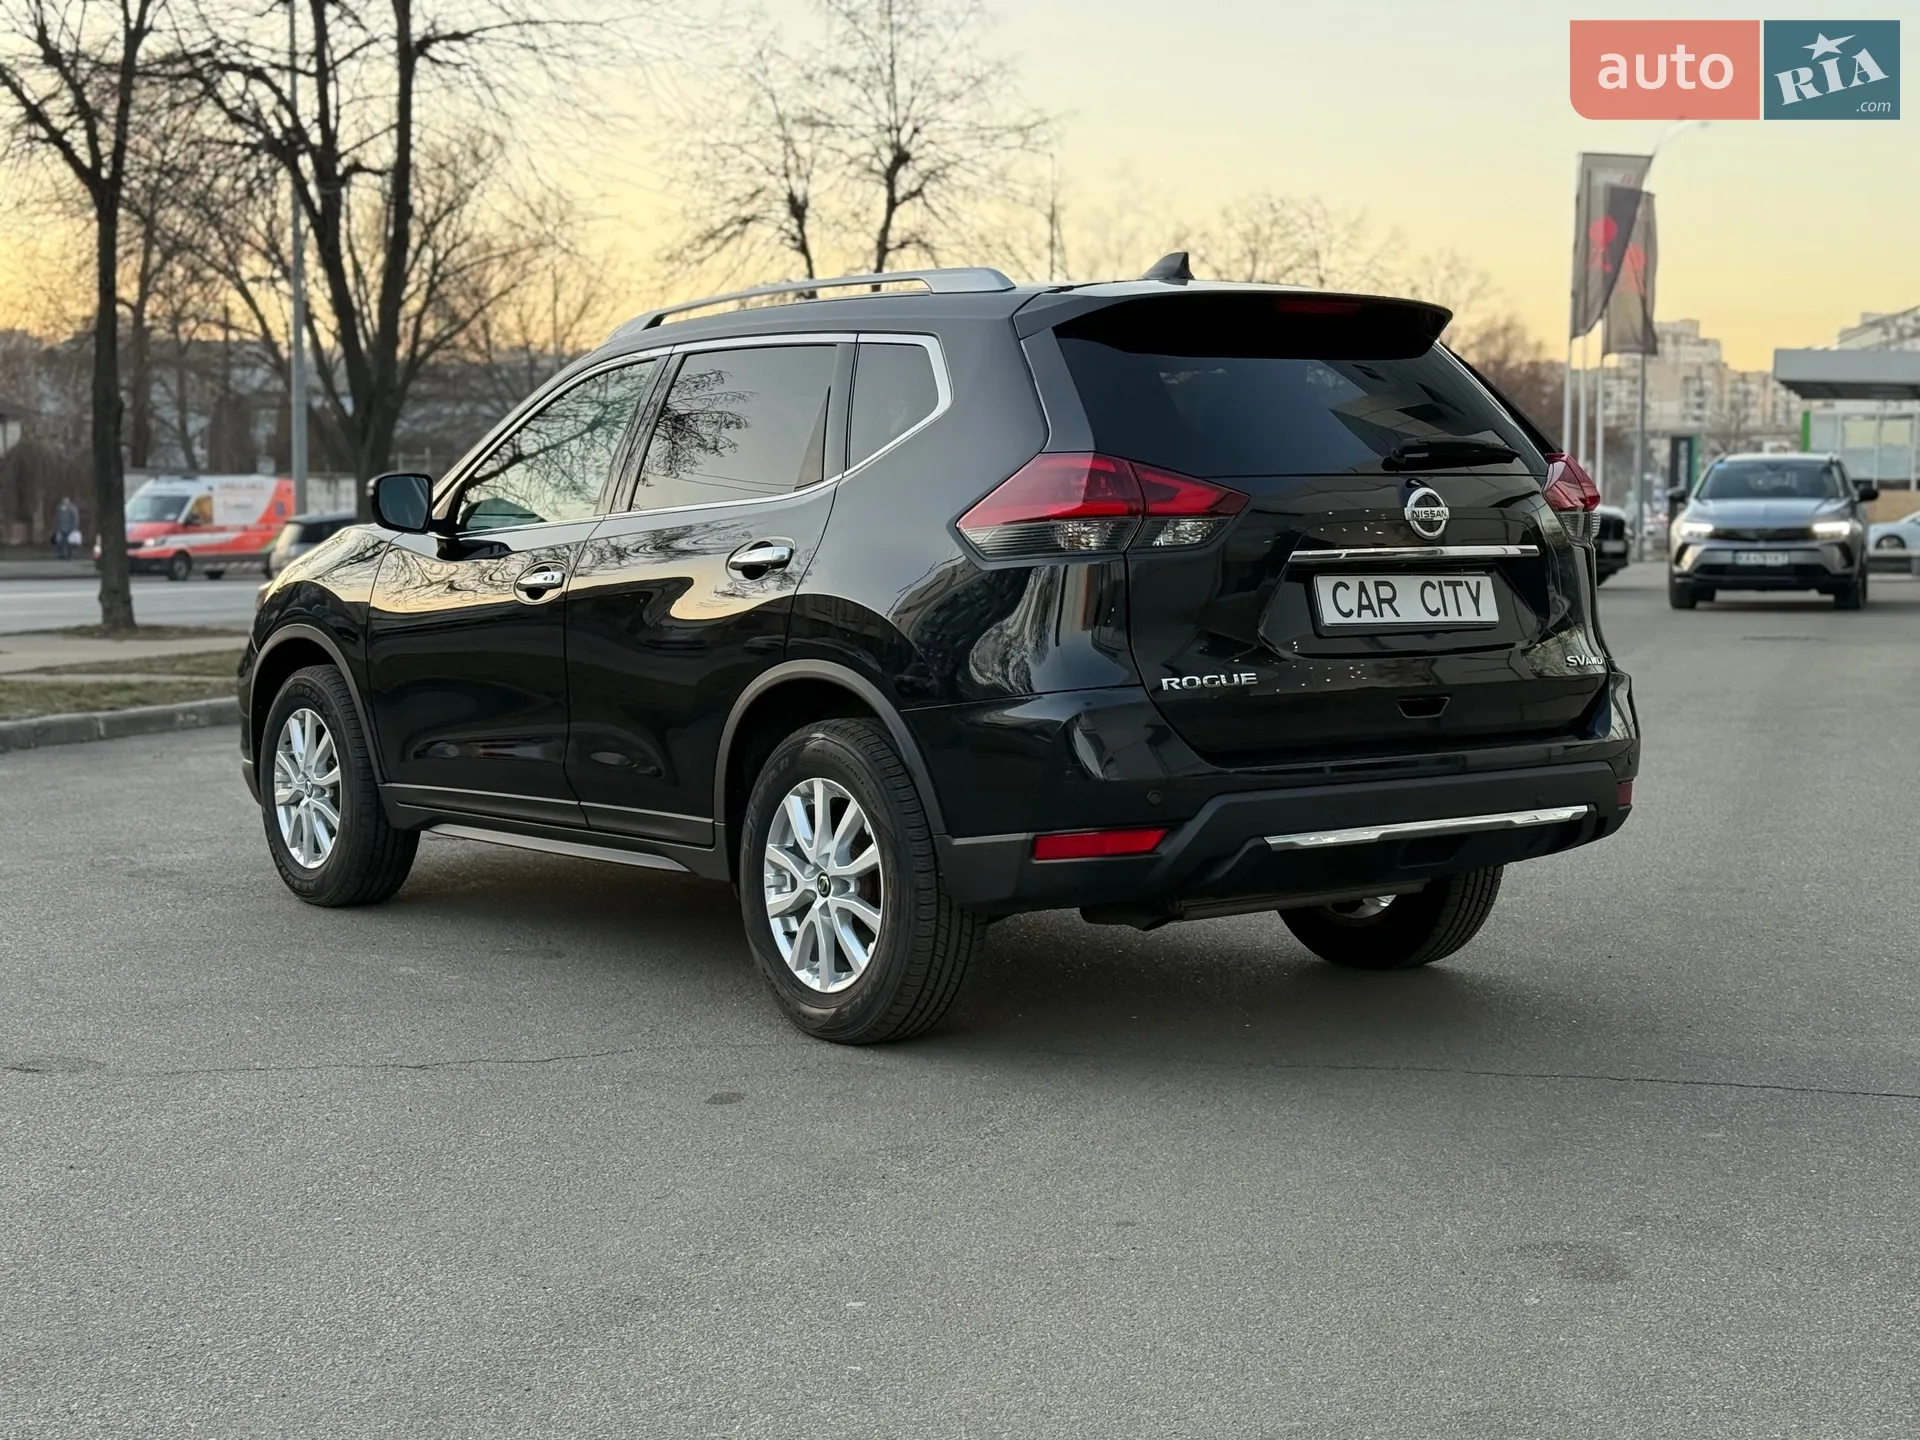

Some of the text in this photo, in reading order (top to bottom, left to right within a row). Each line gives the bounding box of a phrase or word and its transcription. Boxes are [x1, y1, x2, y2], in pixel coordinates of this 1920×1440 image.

[1412, 508, 1448, 519] NISSAN
[1332, 580, 1481, 619] CAR CITY
[1160, 672, 1259, 691] ROGUE
